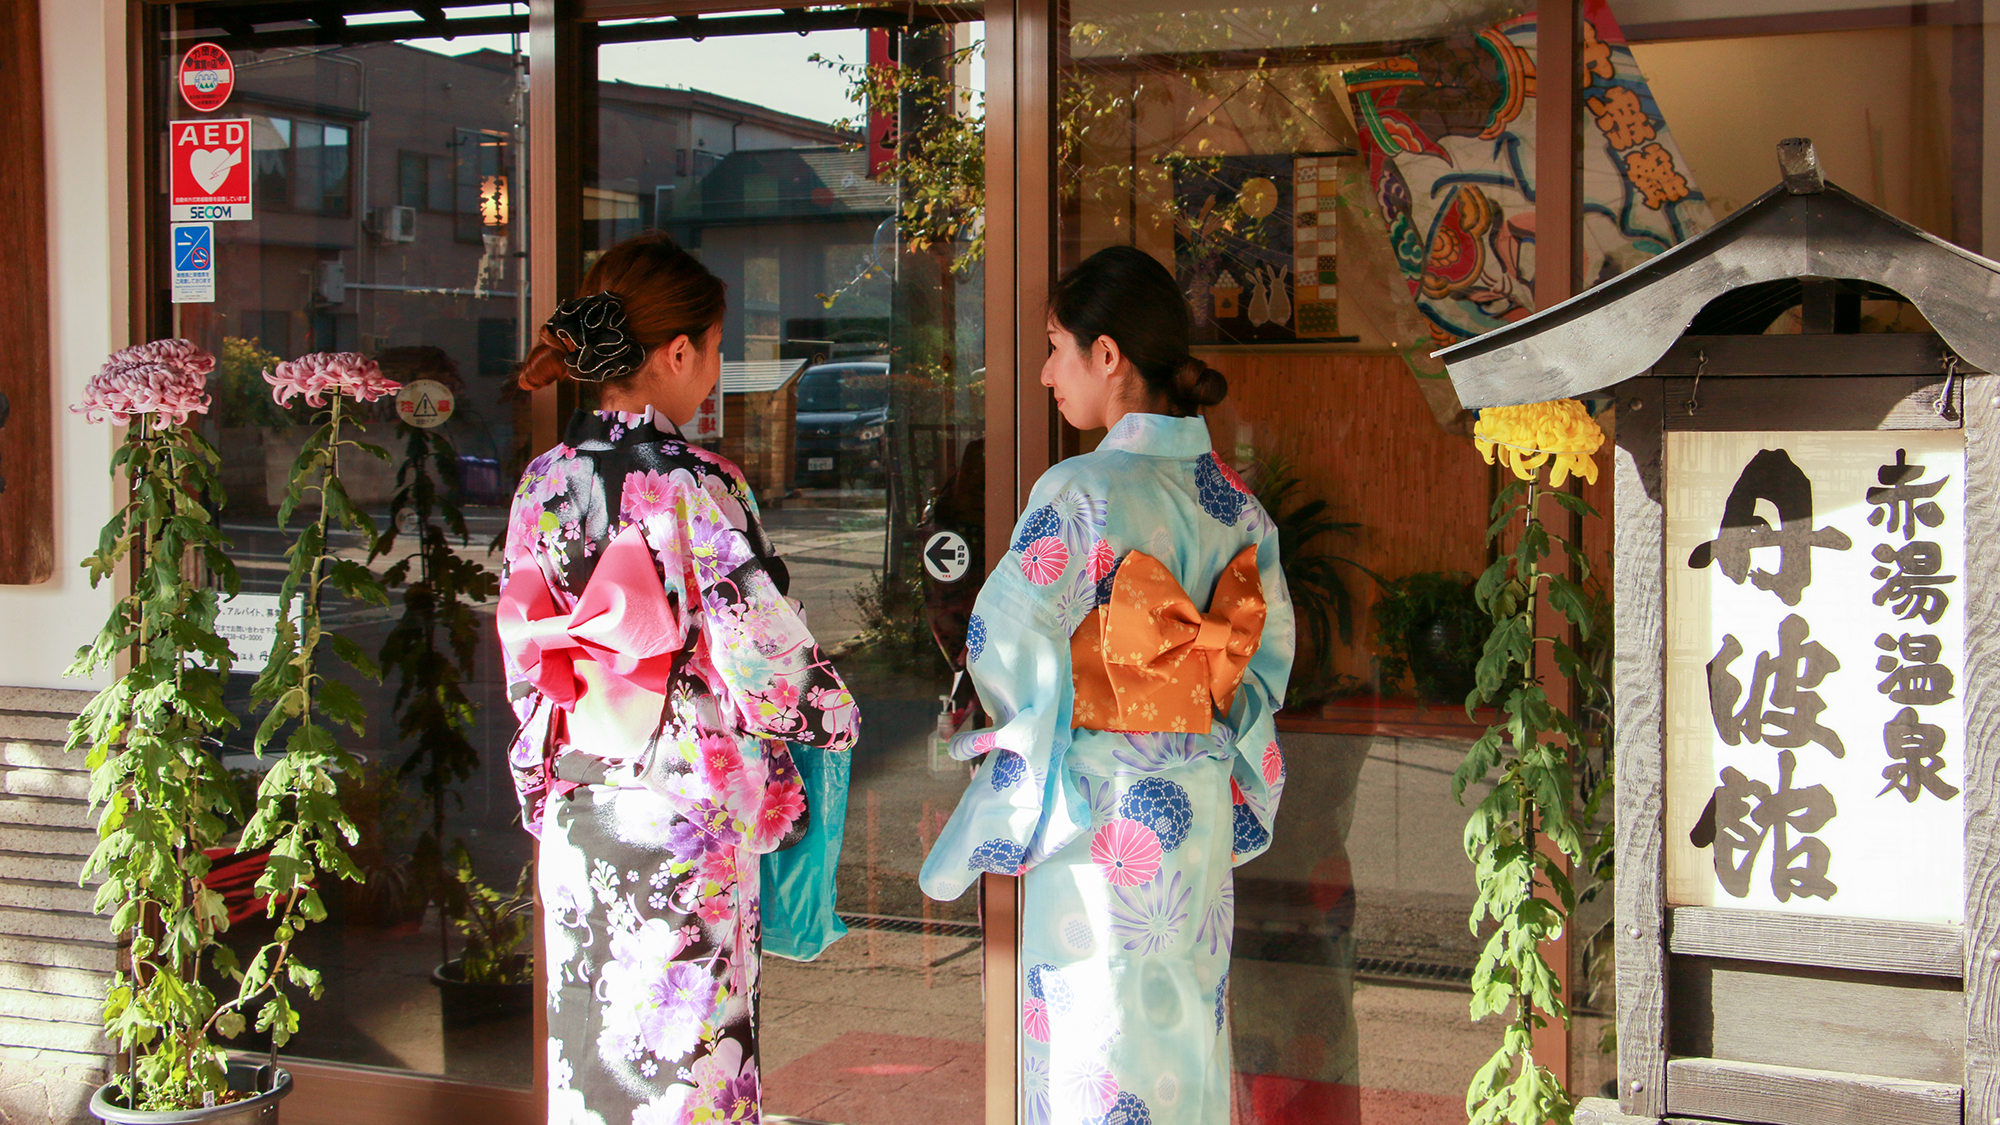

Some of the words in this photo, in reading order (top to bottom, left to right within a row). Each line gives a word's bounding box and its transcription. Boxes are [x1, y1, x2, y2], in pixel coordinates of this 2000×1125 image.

[177, 123, 244, 146] AED
[190, 205, 232, 219] SECOM
[401, 400, 414, 413] 注
[1865, 448, 1959, 803] 赤湯温泉
[1687, 448, 1852, 903] 丹波館
